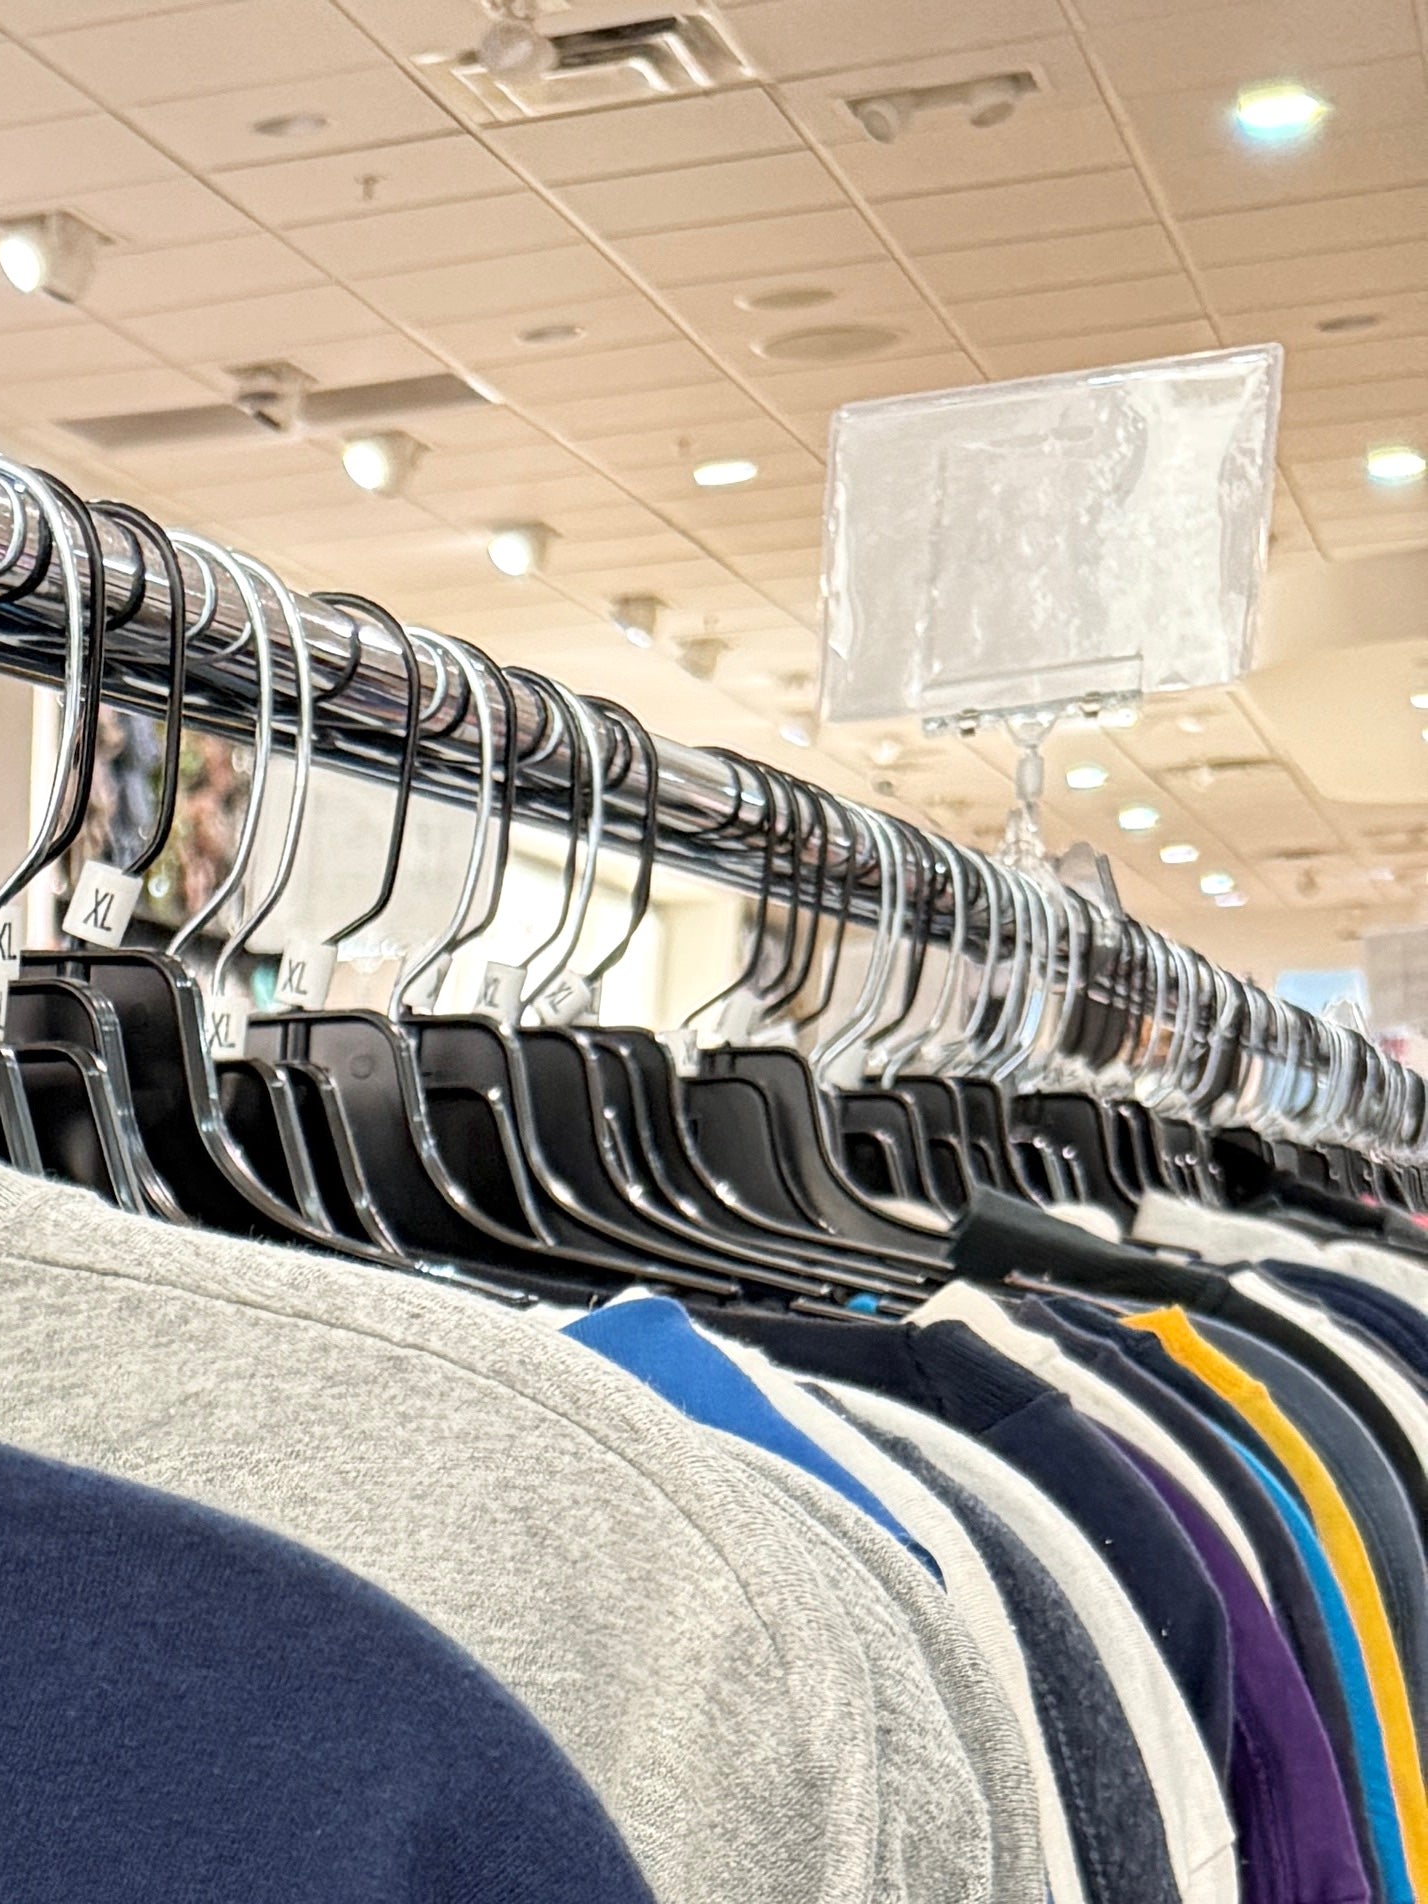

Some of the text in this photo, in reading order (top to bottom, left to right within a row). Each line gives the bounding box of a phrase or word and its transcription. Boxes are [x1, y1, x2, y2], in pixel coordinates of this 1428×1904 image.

[82, 888, 116, 932] XL
[280, 959, 308, 996] XL
[208, 1012, 237, 1049] XL
